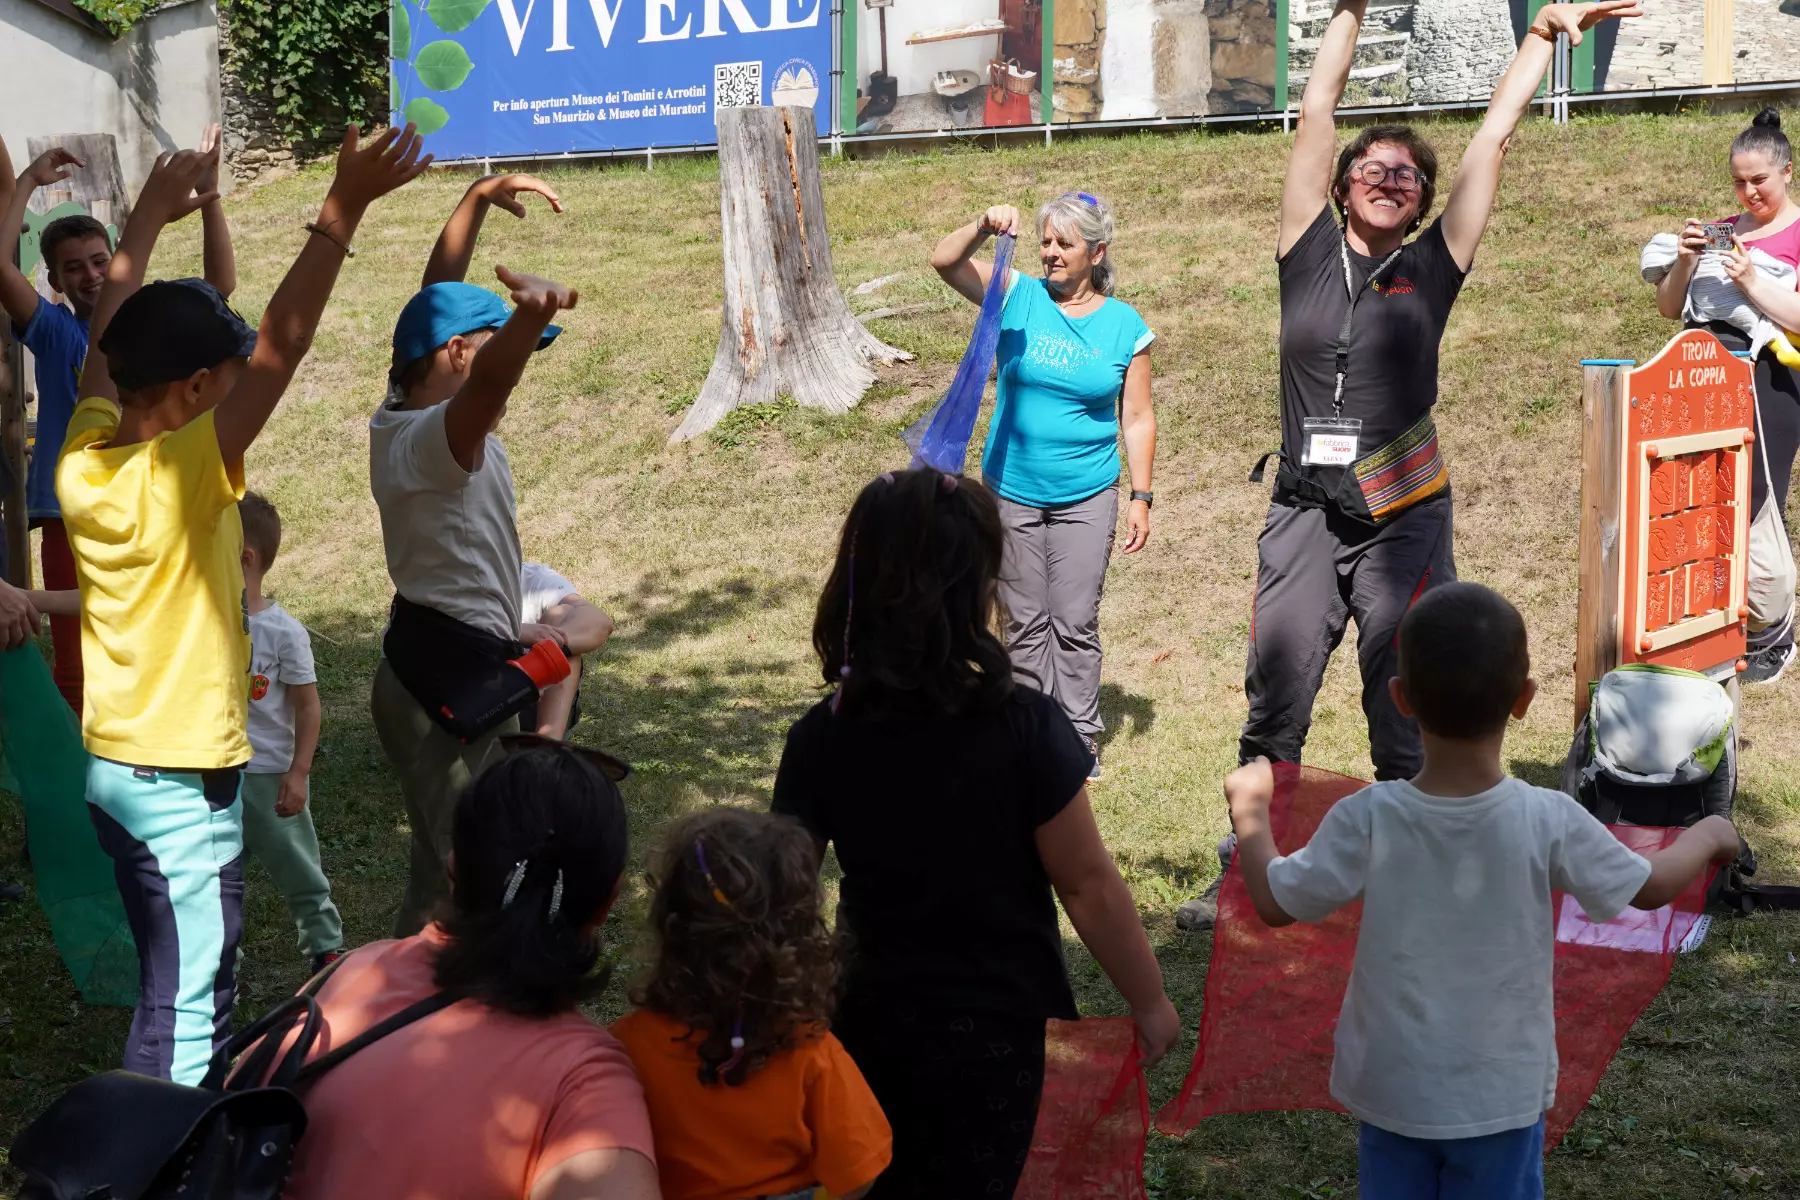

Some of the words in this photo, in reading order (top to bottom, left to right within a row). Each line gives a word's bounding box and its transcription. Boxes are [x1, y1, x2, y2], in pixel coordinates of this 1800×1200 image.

[493, 101, 509, 112] Per
[511, 99, 529, 111] info
[530, 97, 569, 112] apertura
[572, 94, 603, 107] Museo
[605, 92, 620, 104] dei
[621, 89, 655, 103] Tomini
[657, 91, 663, 100] e
[664, 85, 706, 99] Arrotini
[533, 113, 550, 125] San
[552, 110, 595, 124] Maurizio
[597, 109, 607, 121] &
[609, 107, 640, 120] Museo
[642, 105, 657, 117] dei
[659, 102, 706, 116] Muratori
[1682, 341, 1718, 361] TROVA
[1669, 369, 1684, 389] LA
[1689, 365, 1727, 387] COPPIA
